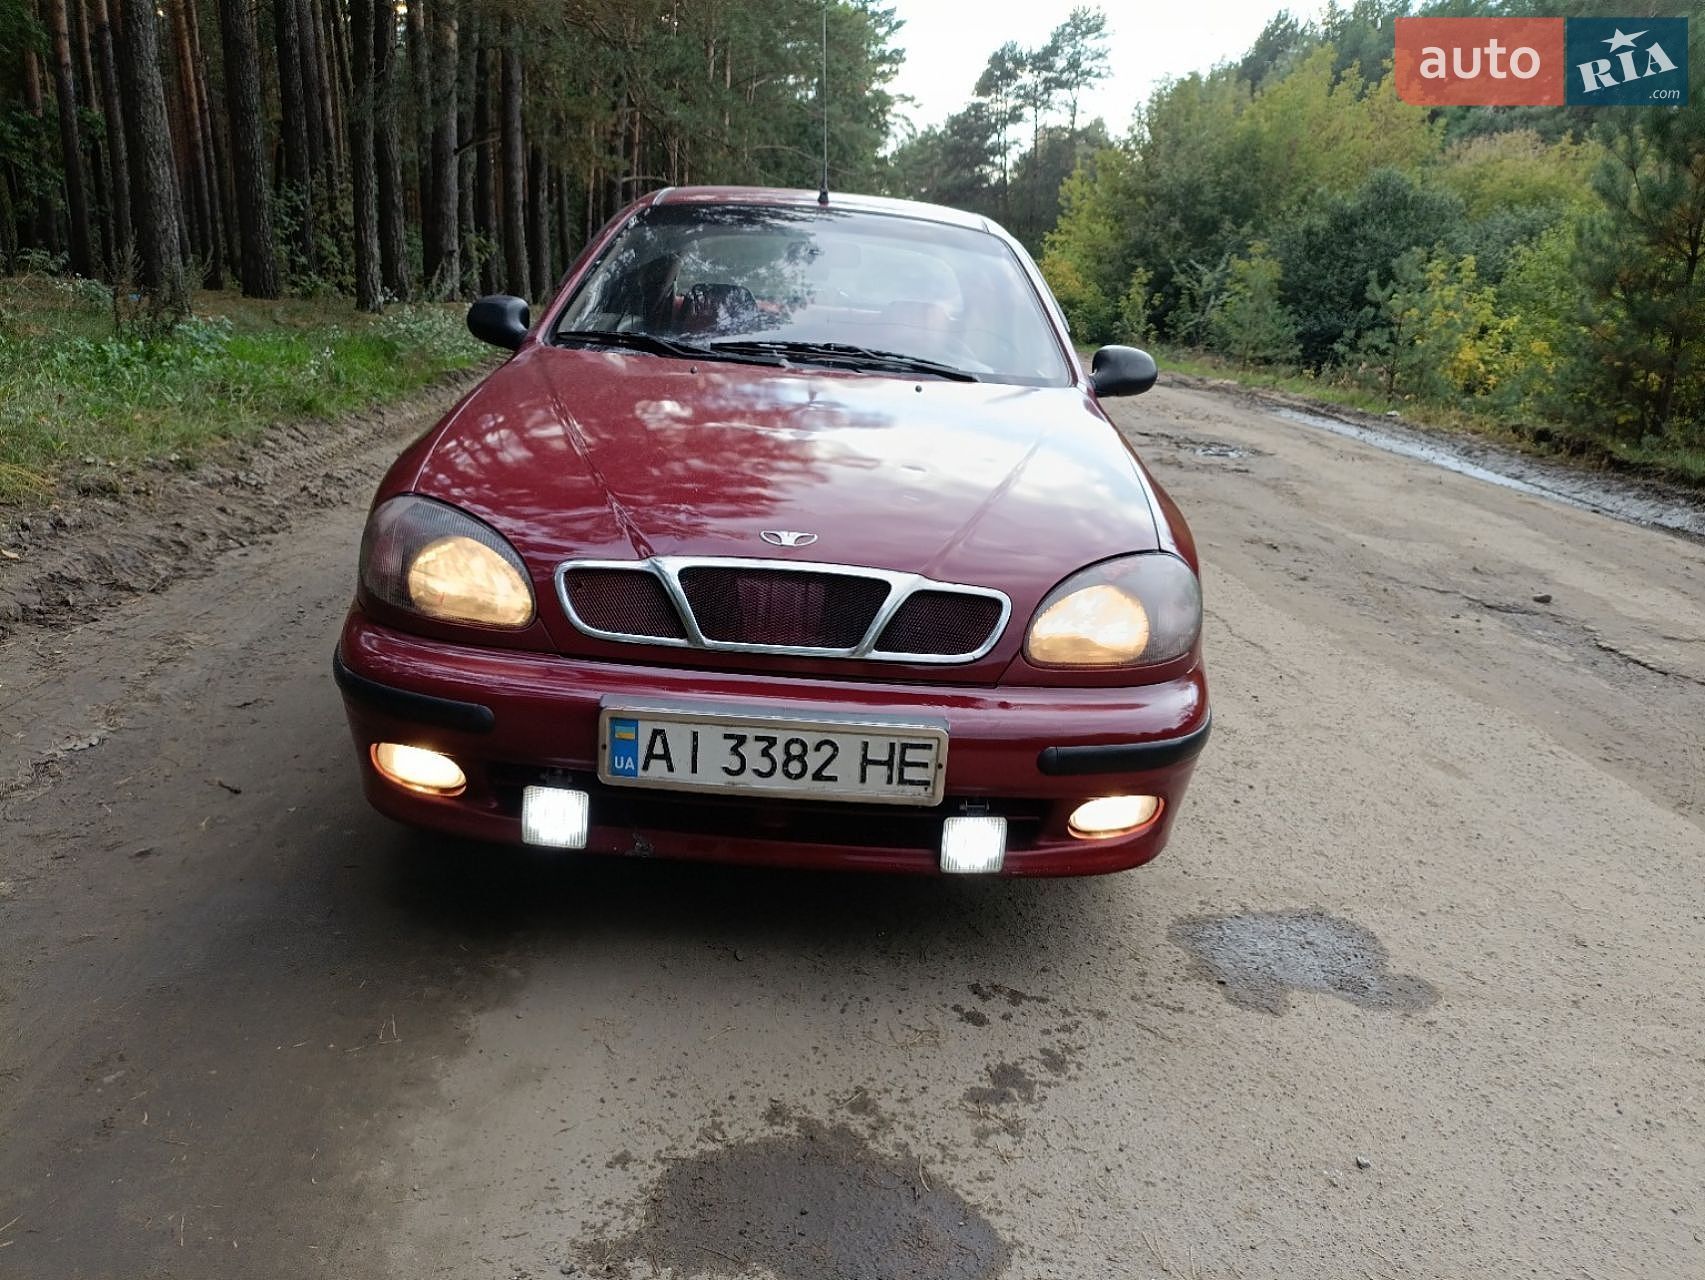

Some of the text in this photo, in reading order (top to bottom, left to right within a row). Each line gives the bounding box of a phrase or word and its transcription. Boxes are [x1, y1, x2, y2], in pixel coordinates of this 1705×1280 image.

[614, 756, 635, 770] UA
[641, 728, 933, 786] AI 3382 HE
